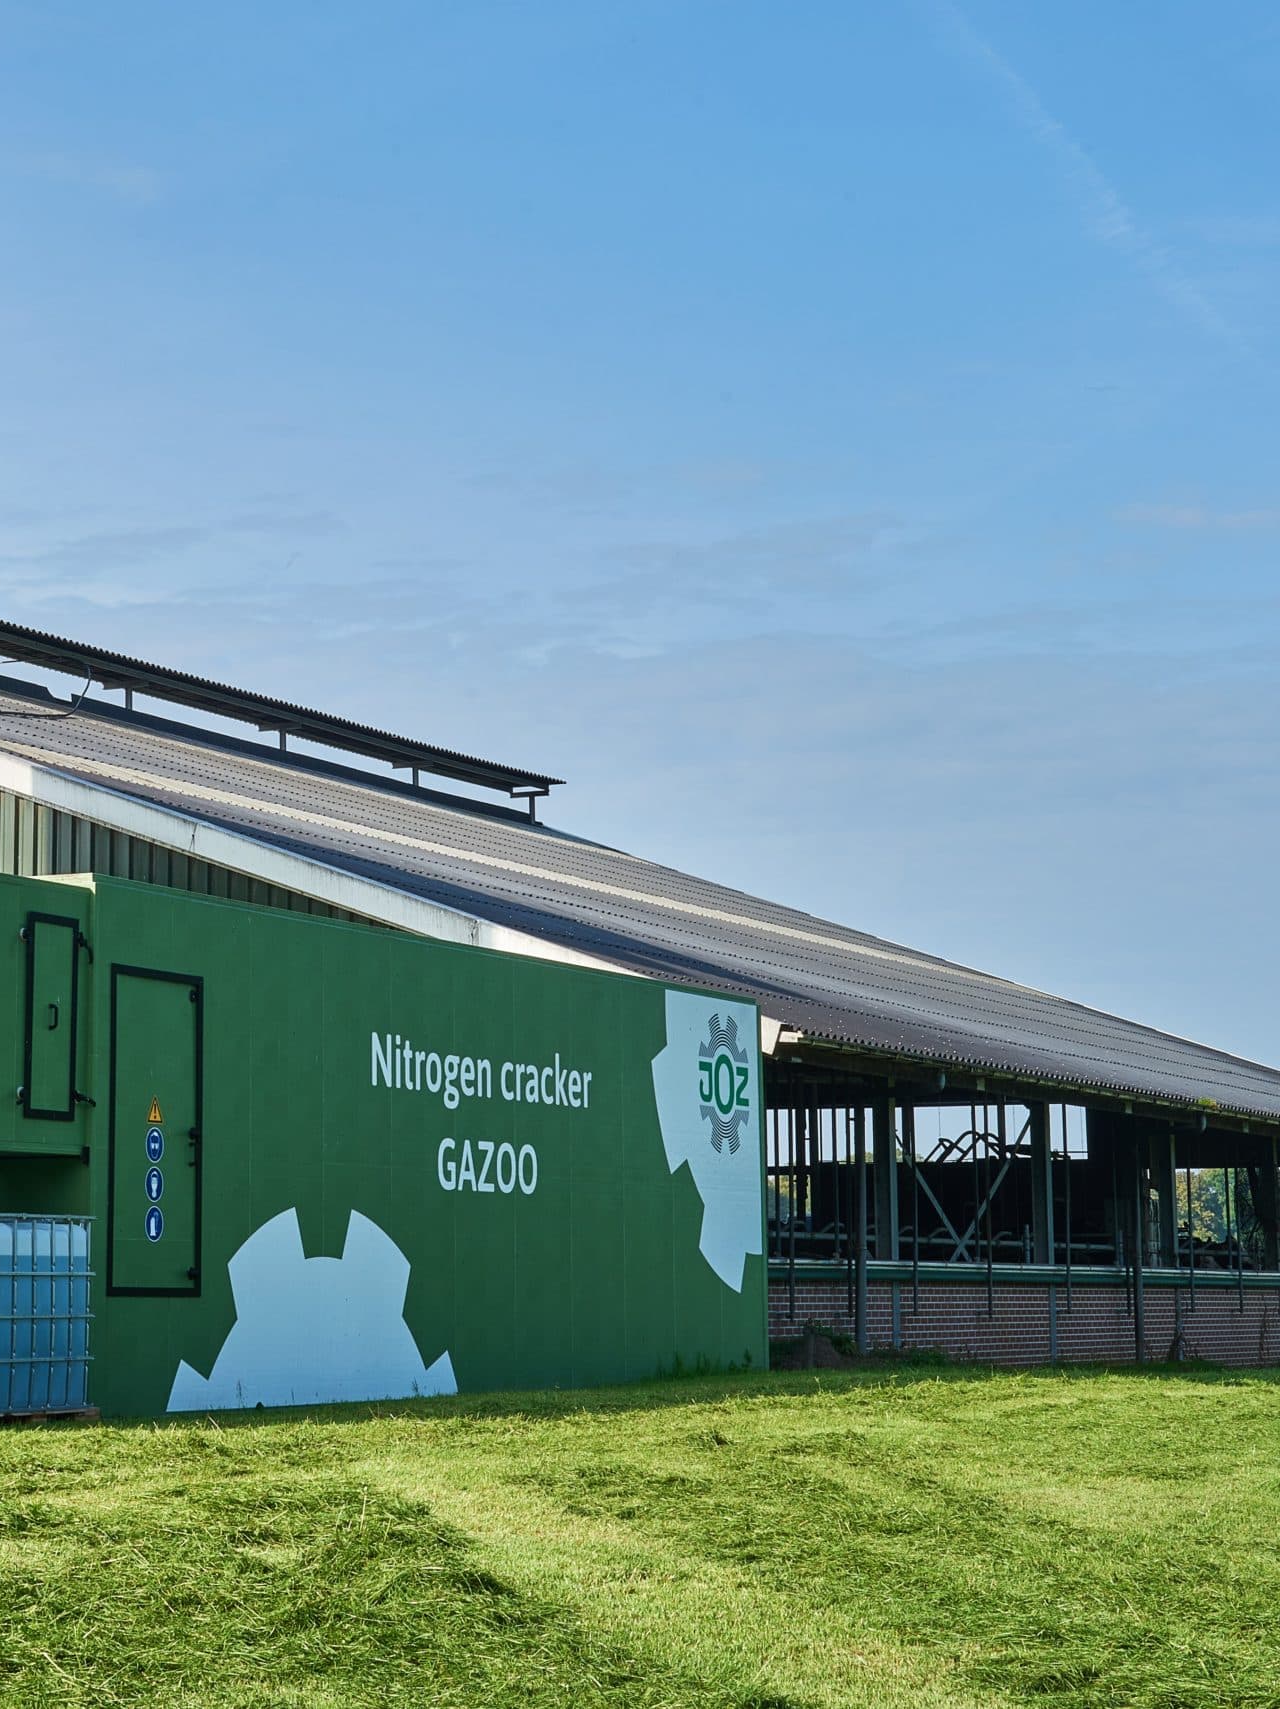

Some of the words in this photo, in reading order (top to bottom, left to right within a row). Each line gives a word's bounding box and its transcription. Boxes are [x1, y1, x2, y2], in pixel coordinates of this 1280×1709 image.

[371, 1031, 492, 1109] Nitrogen
[500, 1053, 592, 1108] cracker
[698, 1053, 750, 1115] JOZ
[437, 1137, 538, 1195] GAZOO
